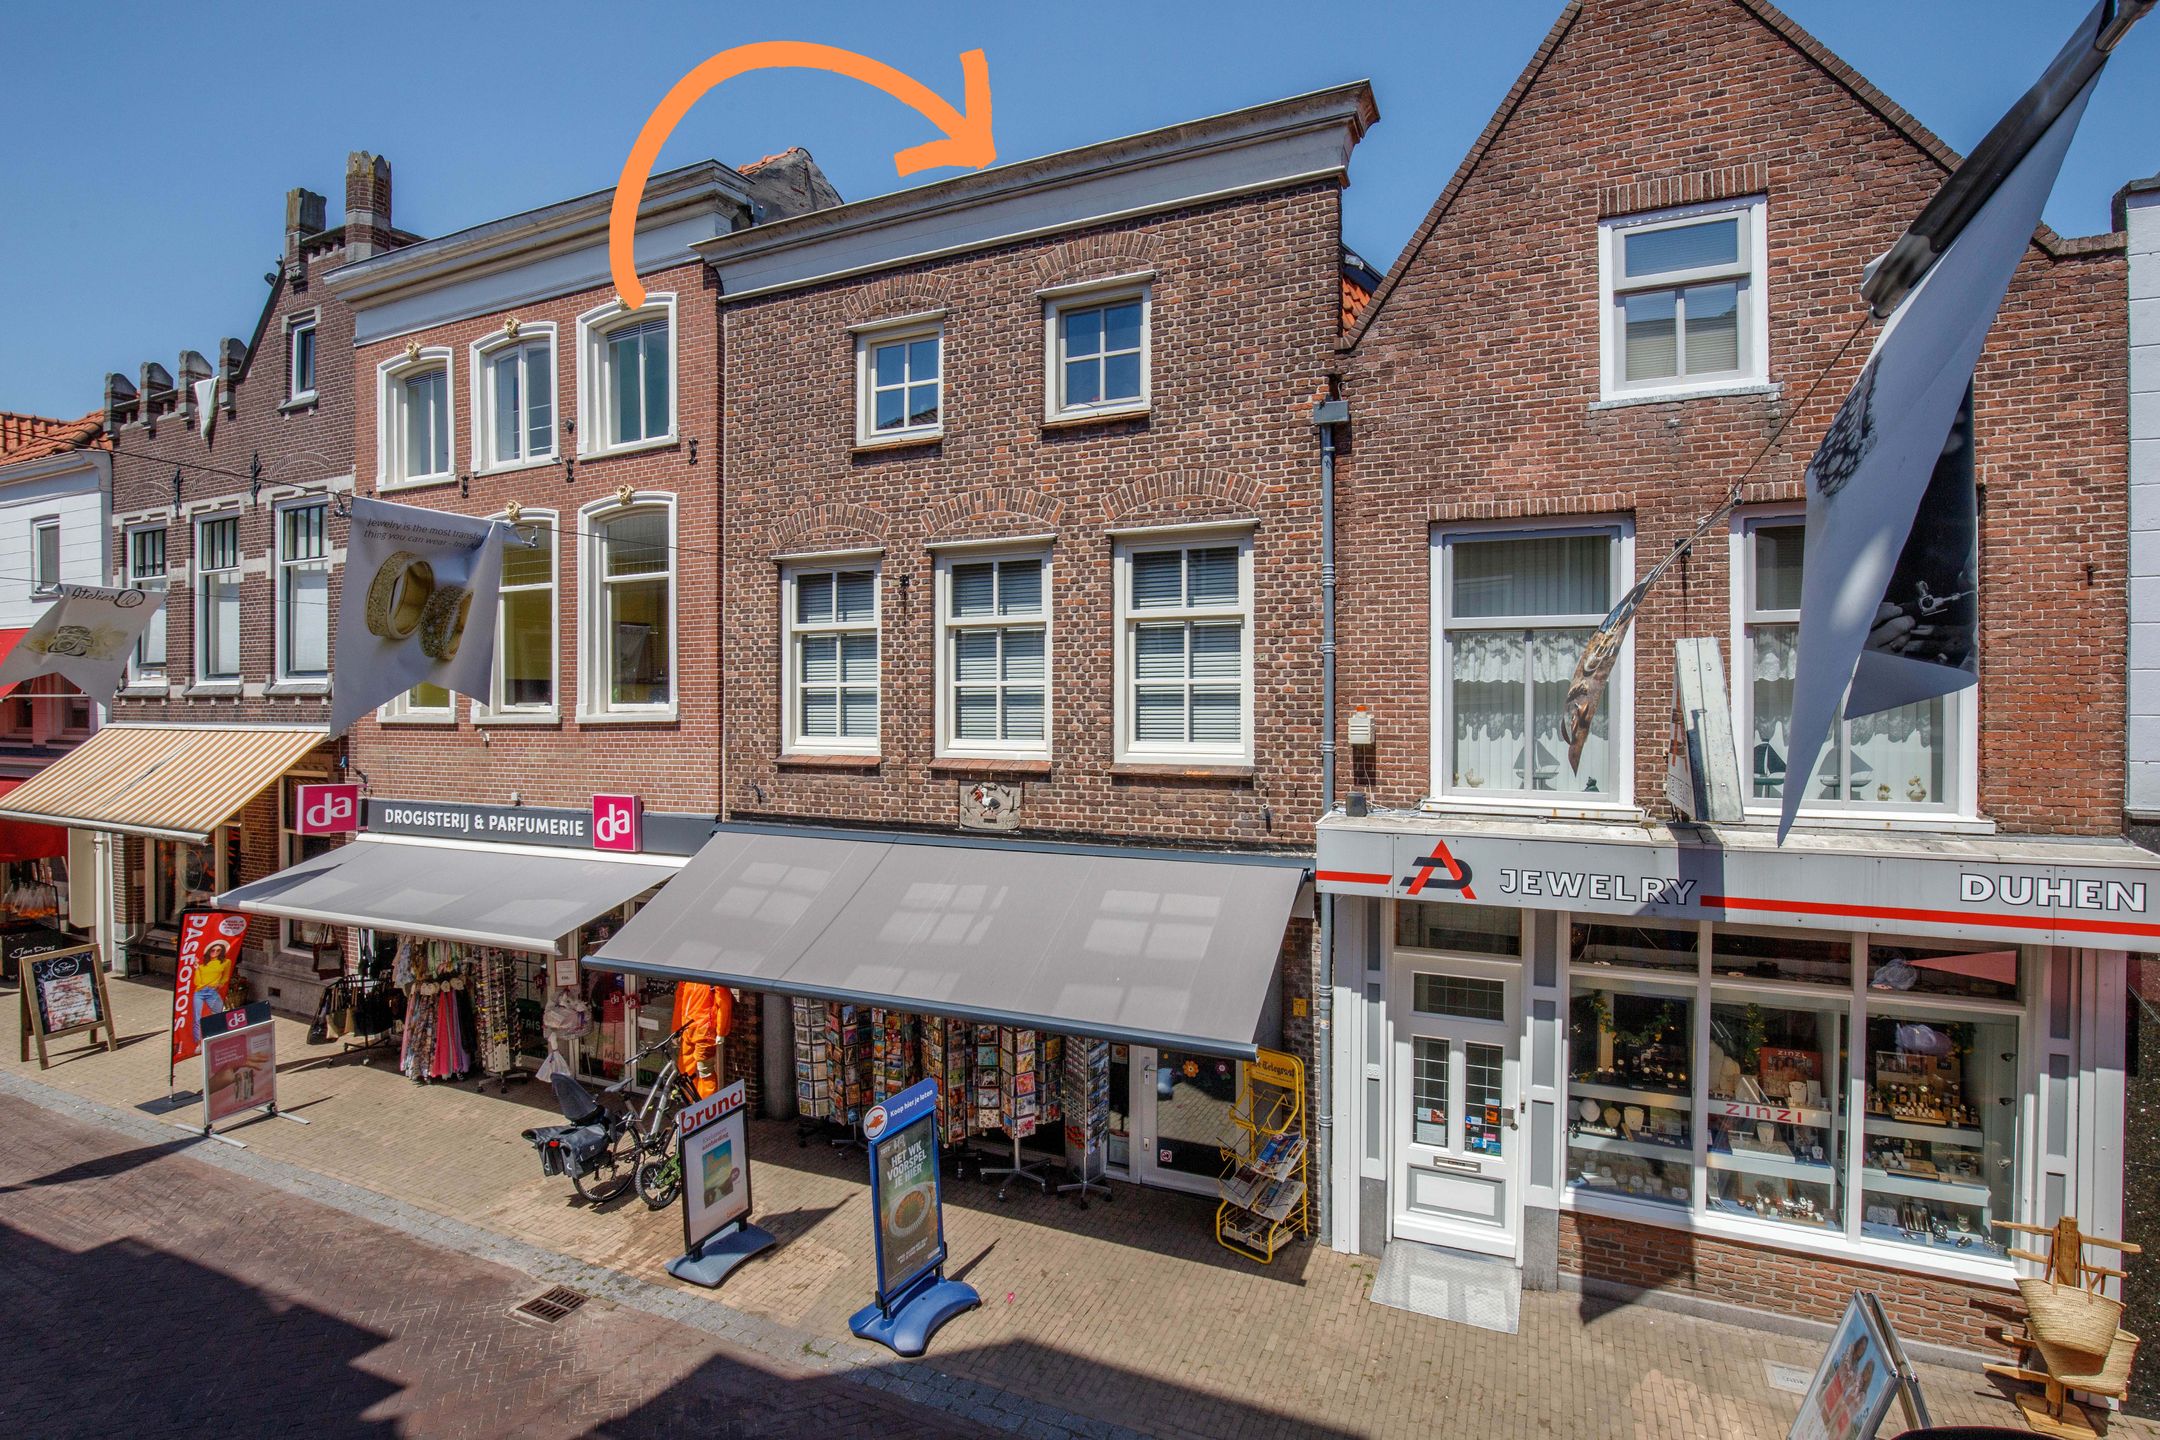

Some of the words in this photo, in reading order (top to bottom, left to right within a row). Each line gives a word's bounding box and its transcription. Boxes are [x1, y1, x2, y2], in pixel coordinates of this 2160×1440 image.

[363, 530, 387, 541] thing
[388, 532, 405, 542] you
[407, 535, 424, 543] can
[425, 538, 447, 546] wear
[366, 518, 401, 530] Jewelry
[402, 522, 410, 531] is
[412, 523, 428, 533] the
[429, 527, 451, 537] most
[72, 587, 115, 601] Atelier
[306, 792, 352, 827] da
[385, 808, 469, 833] DROGISTERIJ
[474, 814, 485, 830] &
[489, 815, 585, 837] PARFUMERIE
[596, 803, 631, 842] da
[1500, 868, 1697, 906] JEWELRY
[1960, 872, 2147, 913] DUHEN
[174, 915, 208, 1031] PASFOTO'S
[228, 1013, 246, 1027] da
[680, 1089, 743, 1134] bruna
[890, 1105, 904, 1117] Koop
[904, 1099, 915, 1110] hier
[914, 1096, 920, 1106] je
[919, 1089, 933, 1101] loten
[887, 1149, 927, 1181] VOORSPEL
[891, 1149, 907, 1168] HET
[908, 1140, 922, 1157] WK
[894, 1175, 904, 1189] JE
[904, 1162, 922, 1182] HIER
